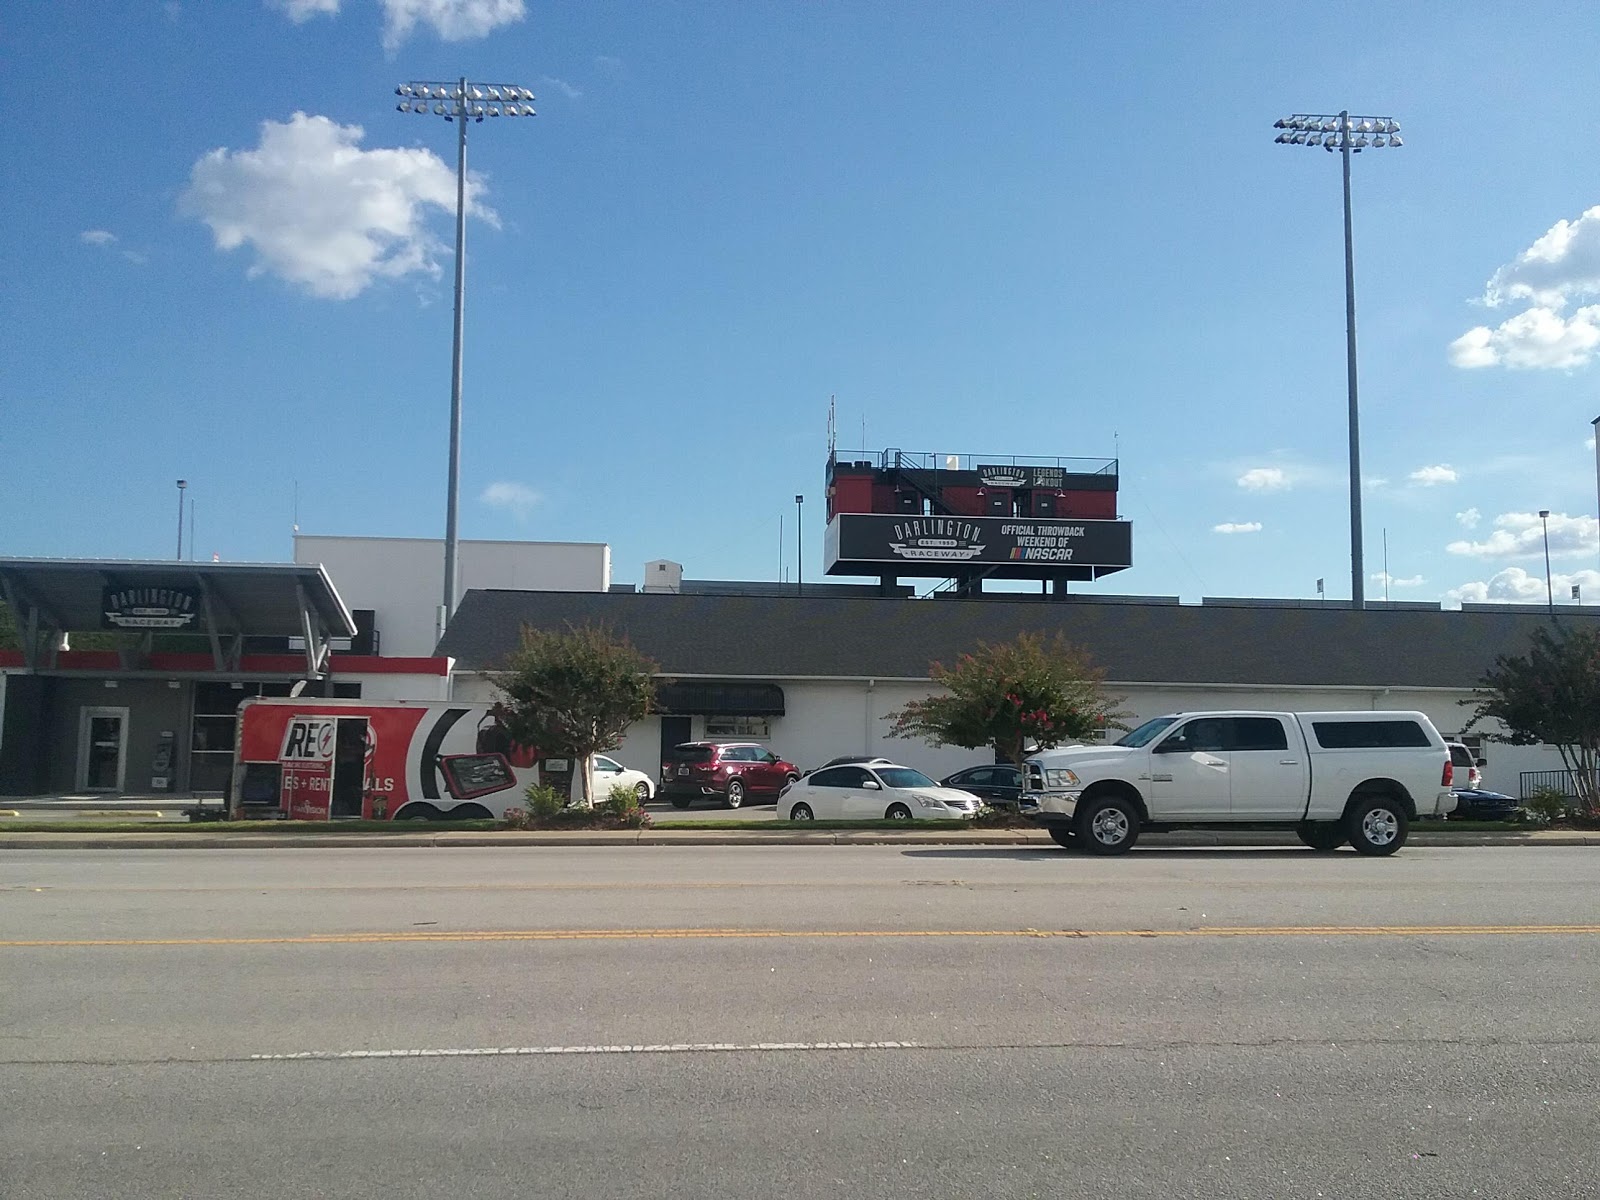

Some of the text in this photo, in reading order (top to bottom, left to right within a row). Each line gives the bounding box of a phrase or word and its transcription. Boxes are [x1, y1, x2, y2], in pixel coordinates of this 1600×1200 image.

[983, 467, 1026, 478] DARLINGTON
[1033, 468, 1063, 477] LEGENDS
[894, 519, 981, 542] DARLINGTON
[1001, 525, 1085, 537] OFFICIAL THROWBACK
[1017, 536, 1069, 547] WEEKEND OF
[910, 550, 966, 558] RACEWAY
[1025, 548, 1073, 560] NASCAR
[110, 588, 193, 610] DARLINGTON
[124, 618, 177, 626] RACEWAY
